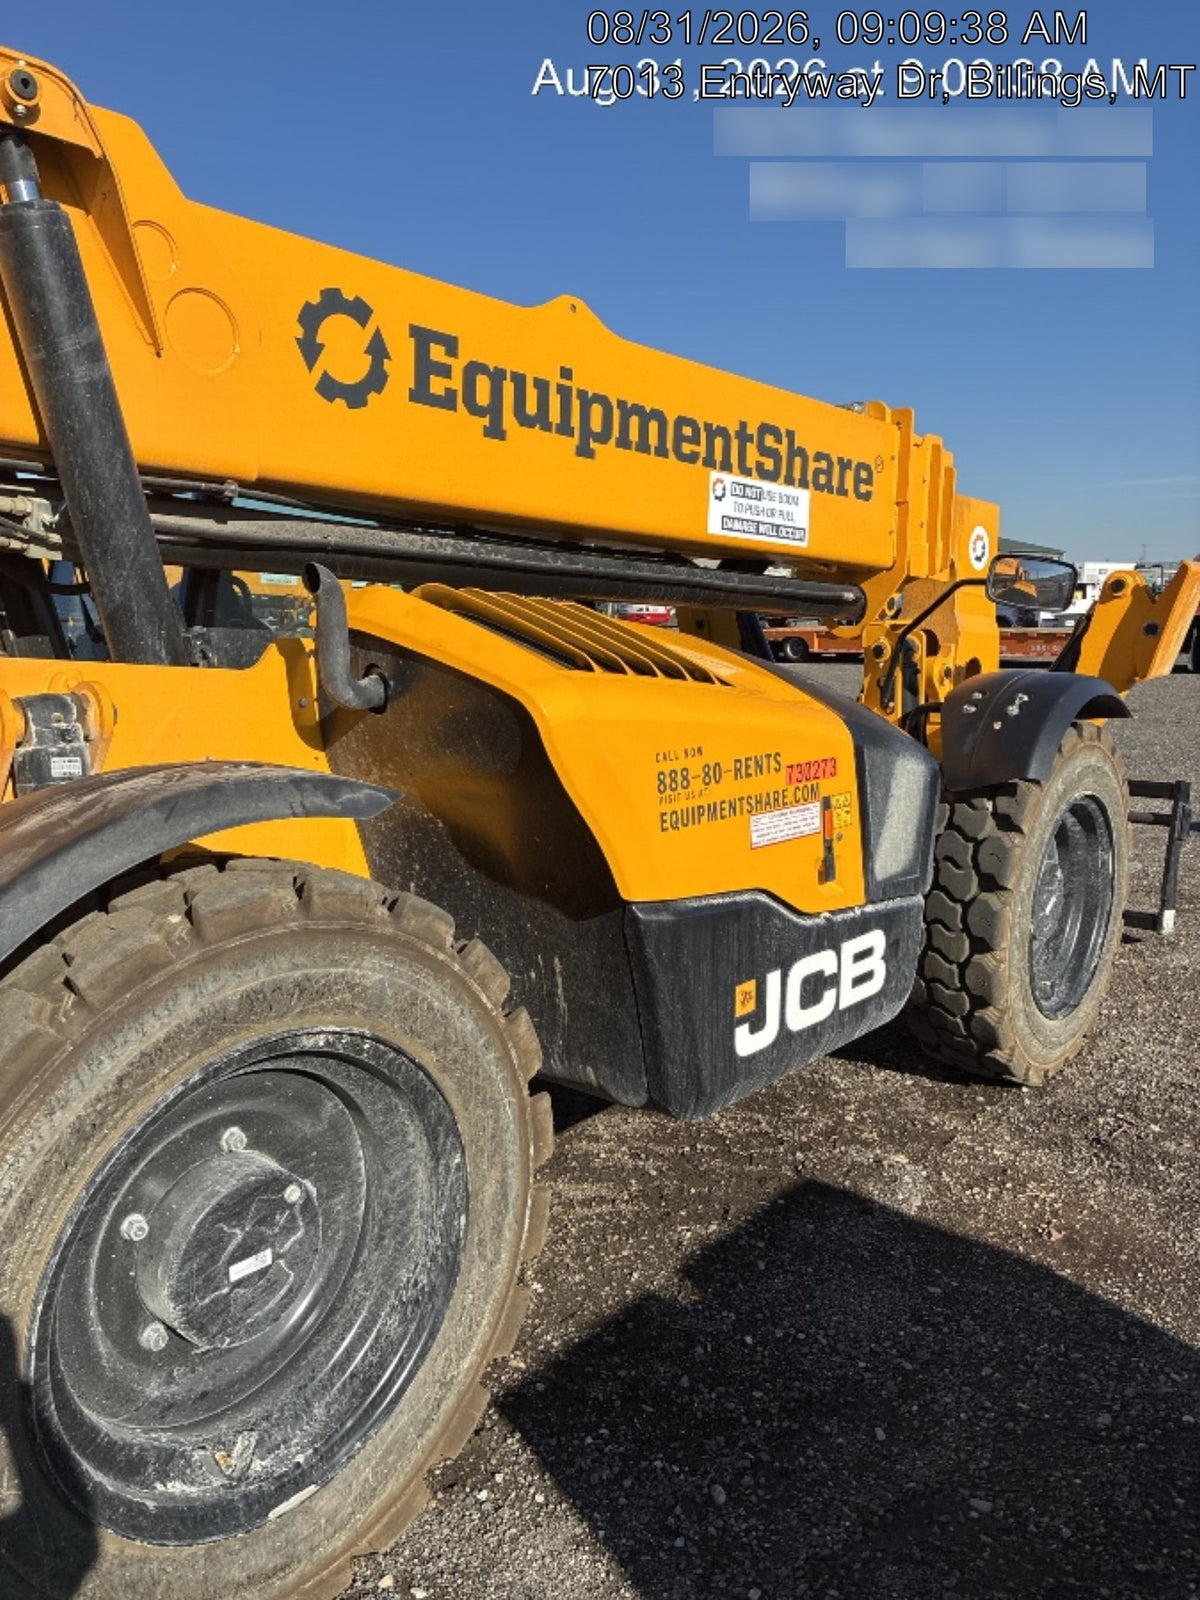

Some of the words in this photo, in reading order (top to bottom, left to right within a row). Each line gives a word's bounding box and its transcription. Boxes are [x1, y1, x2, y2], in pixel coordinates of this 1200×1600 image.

[408, 322, 874, 502] EquipmentShare
[731, 482, 744, 498] DO
[745, 485, 761, 500] NOT
[733, 501, 744, 513] TO
[745, 503, 765, 518] PUSH
[723, 517, 758, 533] DAMAGE
[759, 521, 777, 537] WILL
[778, 525, 805, 541] OCCUR
[656, 749, 680, 763] CALL
[657, 752, 782, 795] 888-80-RENTS
[660, 782, 820, 832] EQUIPMENTSHARE.COM
[735, 929, 886, 1057] JCB
